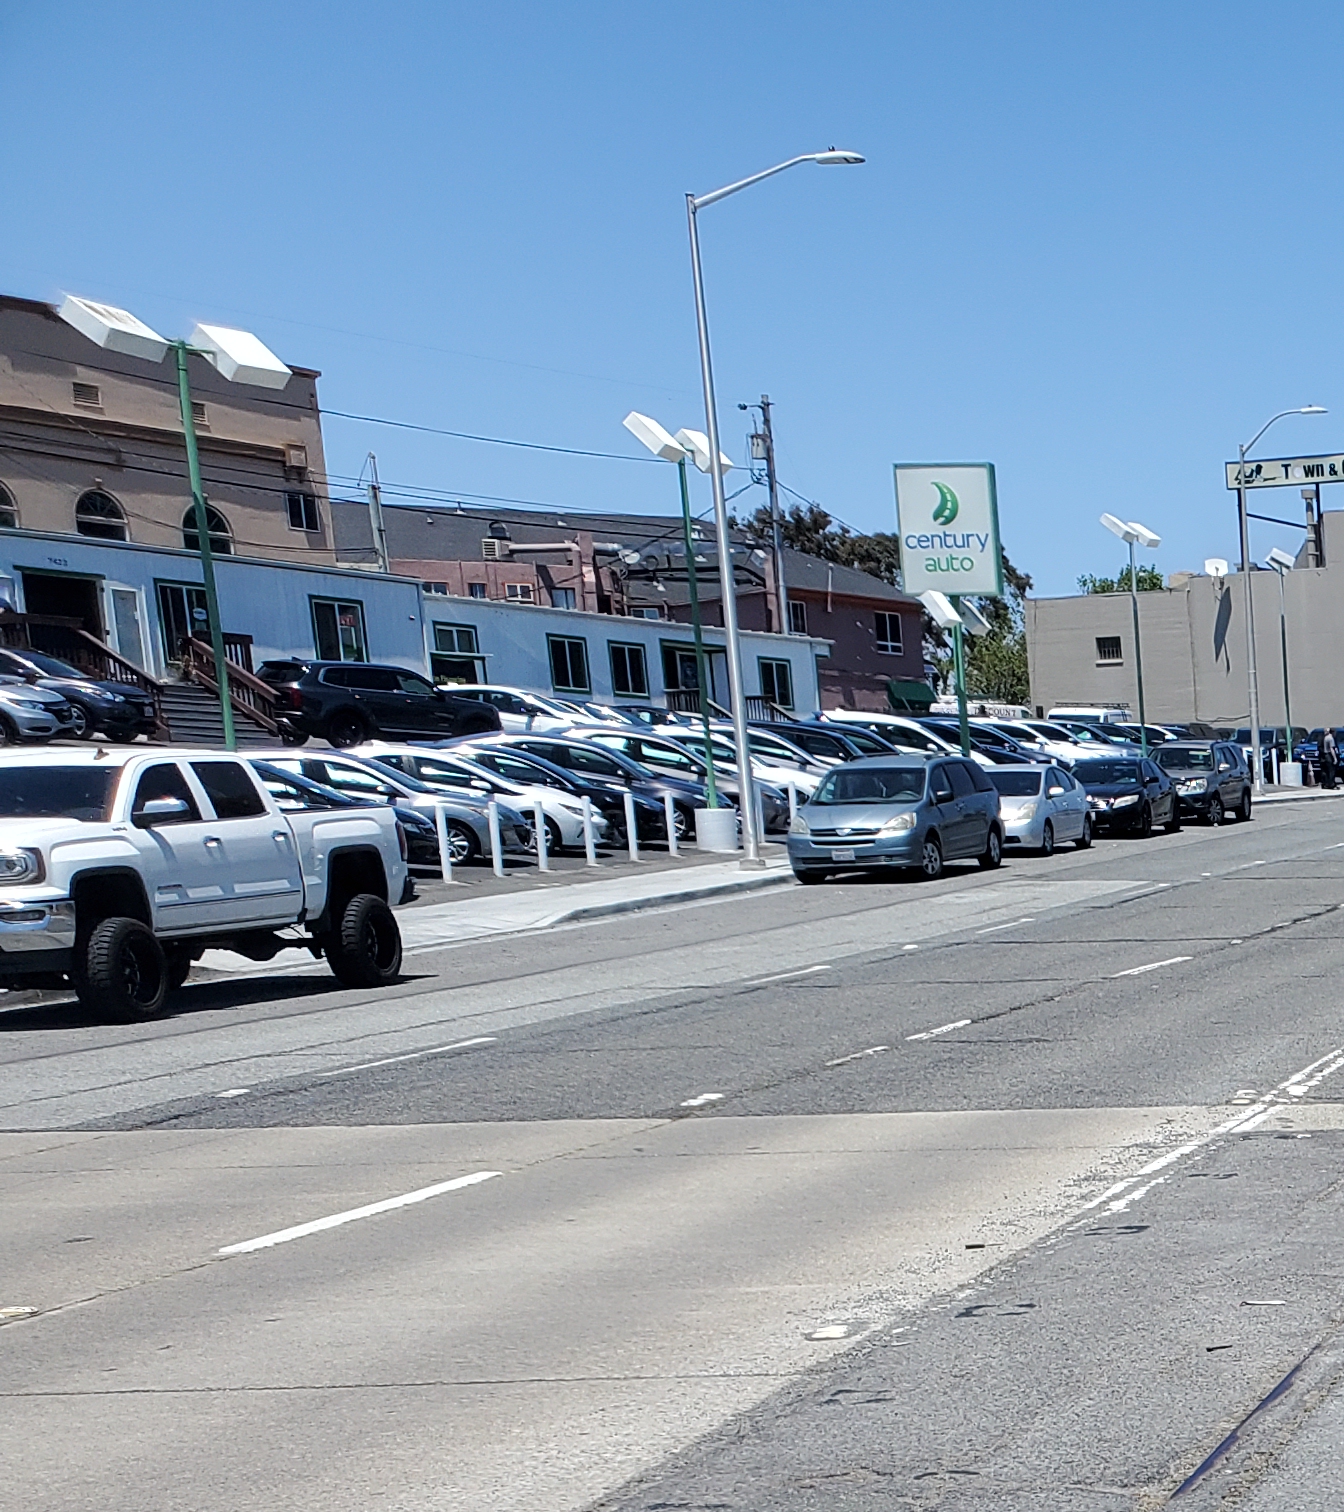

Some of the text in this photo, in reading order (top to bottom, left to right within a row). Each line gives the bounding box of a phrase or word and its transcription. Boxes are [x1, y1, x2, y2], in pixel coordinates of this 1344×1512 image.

[1329, 464, 1338, 477] &
[905, 530, 989, 553] century
[924, 553, 974, 573] auto
